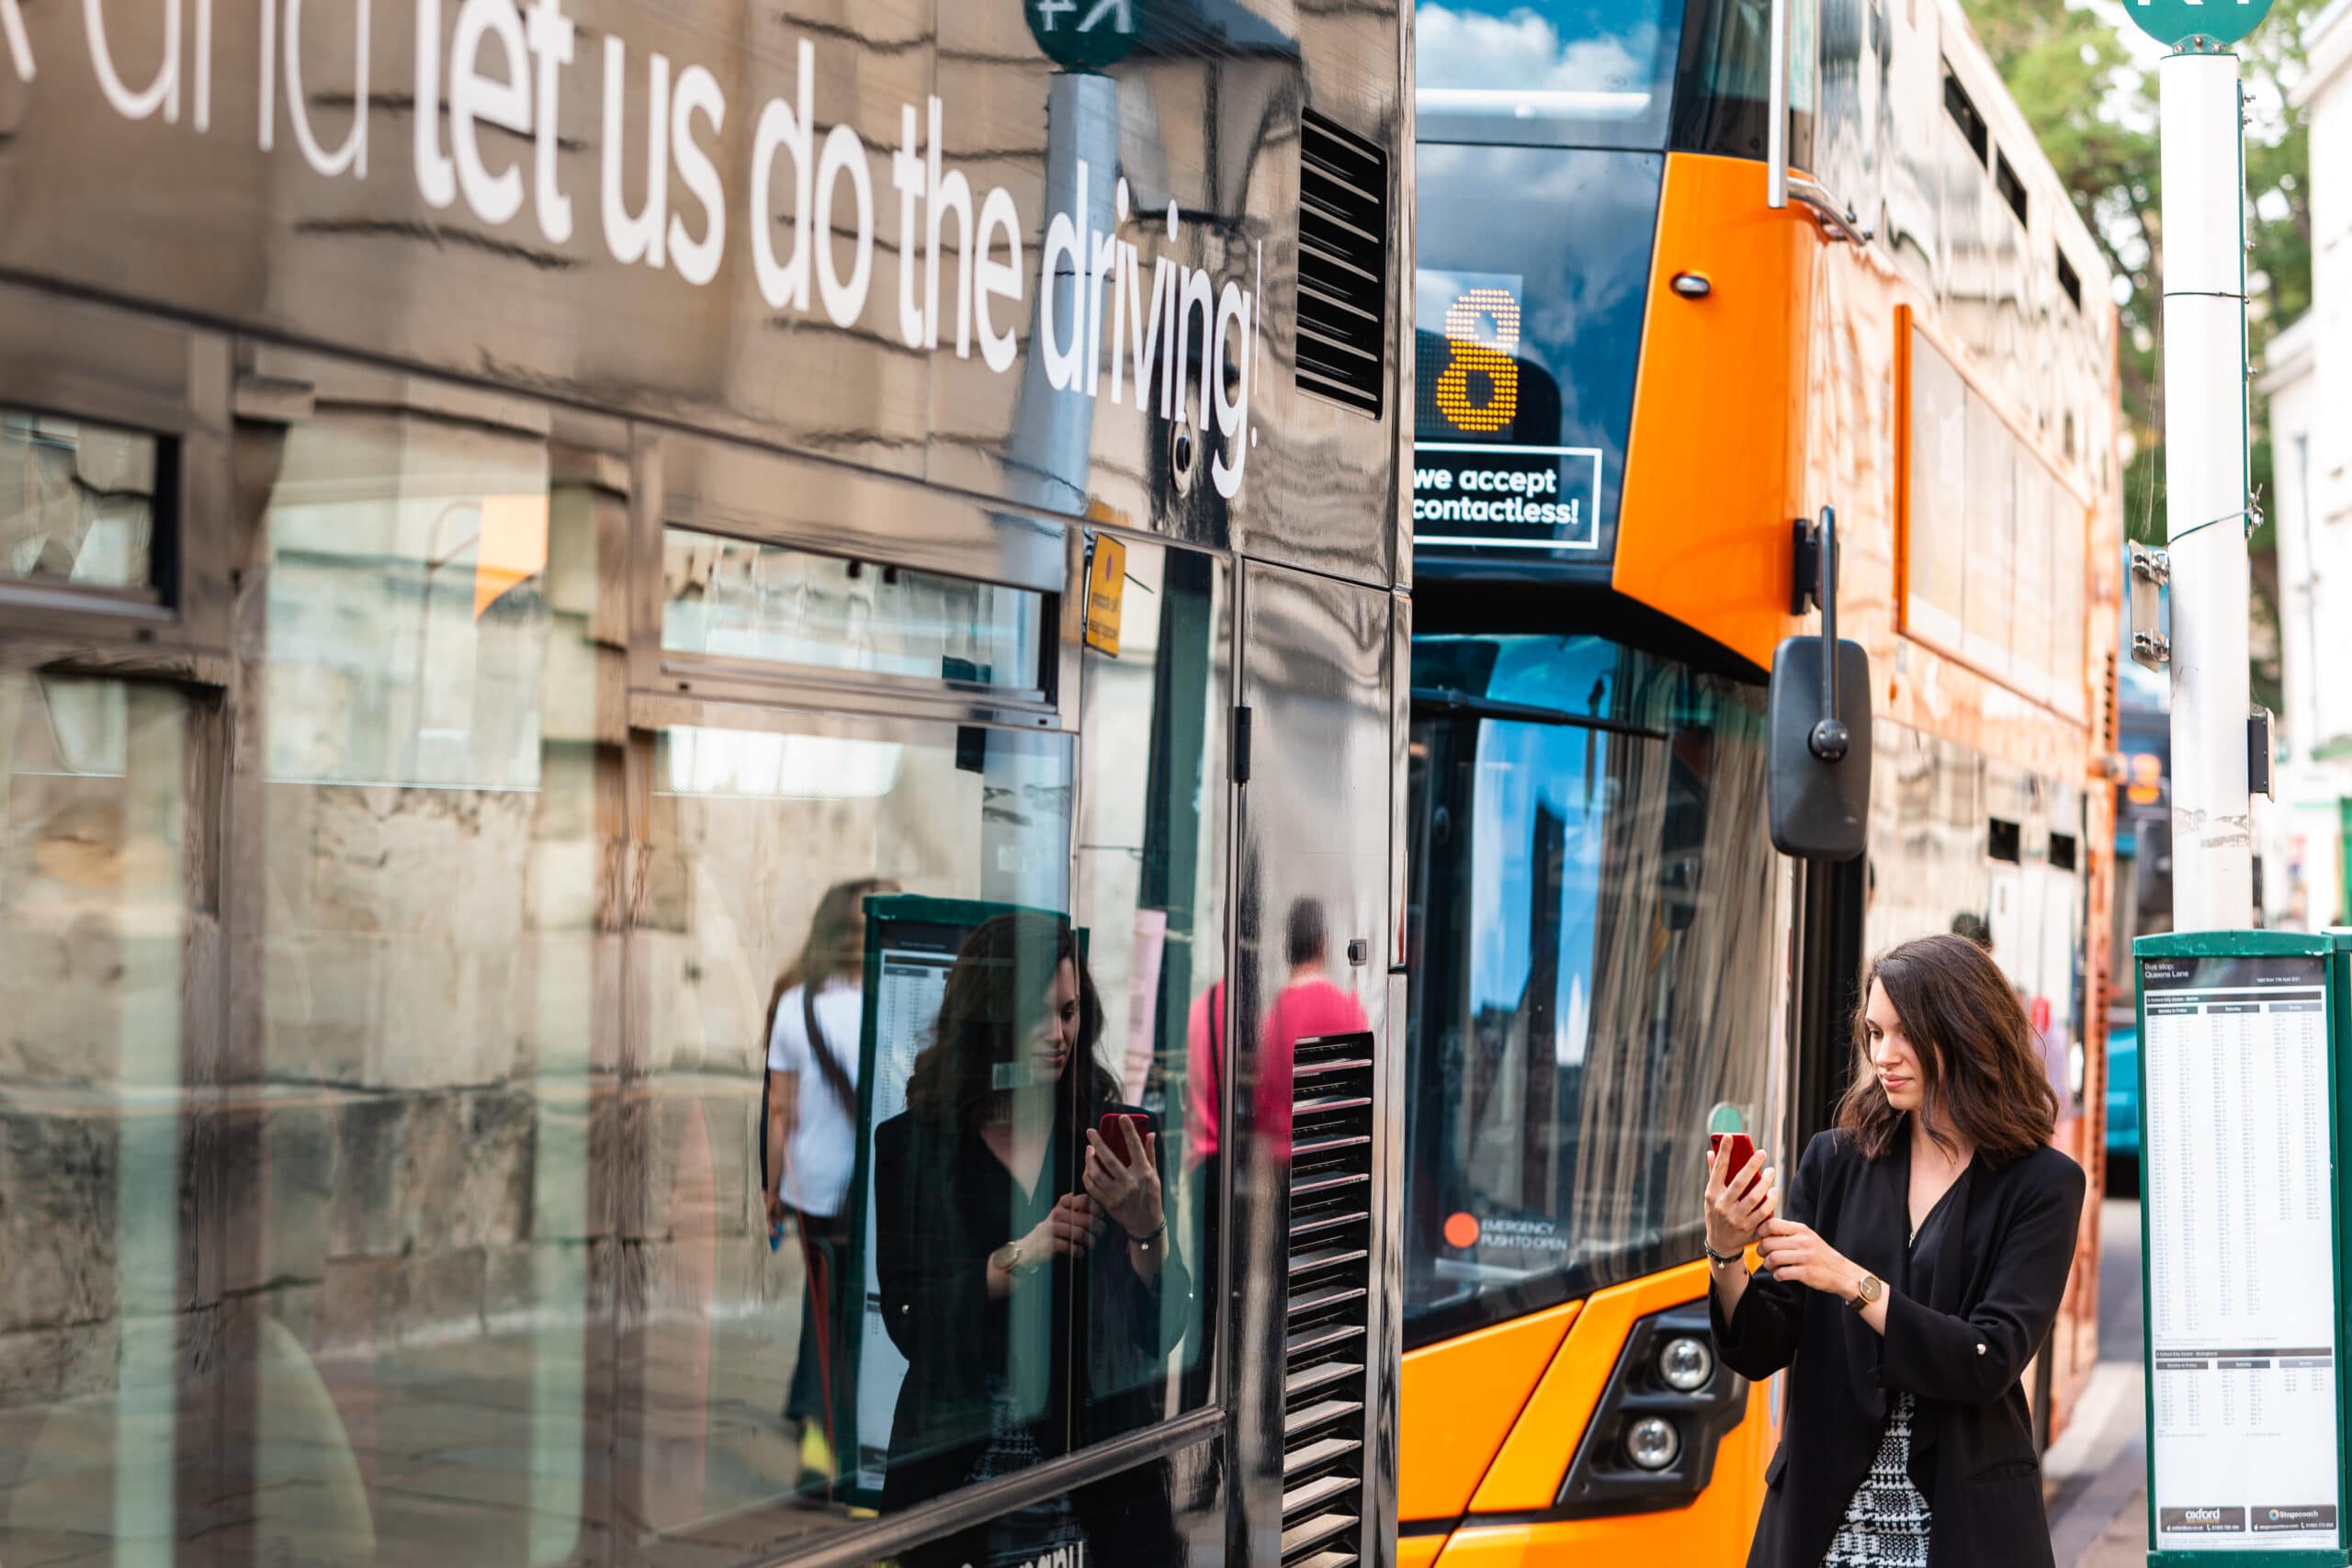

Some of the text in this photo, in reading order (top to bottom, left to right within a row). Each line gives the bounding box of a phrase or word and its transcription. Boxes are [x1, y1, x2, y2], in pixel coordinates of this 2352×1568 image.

[413, 0, 574, 243] let
[602, 35, 727, 285] us
[750, 38, 874, 329] do
[893, 95, 1023, 373] the
[1436, 288, 1521, 432] 8
[1413, 468, 1556, 498] we accept
[1412, 496, 1579, 525] contactless!
[1481, 1218, 1556, 1235] EMERGENCY
[1480, 1234, 1568, 1250] PUSH TO OPEN
[2185, 1508, 2221, 1520] oxford
[2278, 1509, 2319, 1520] Stagecoach
